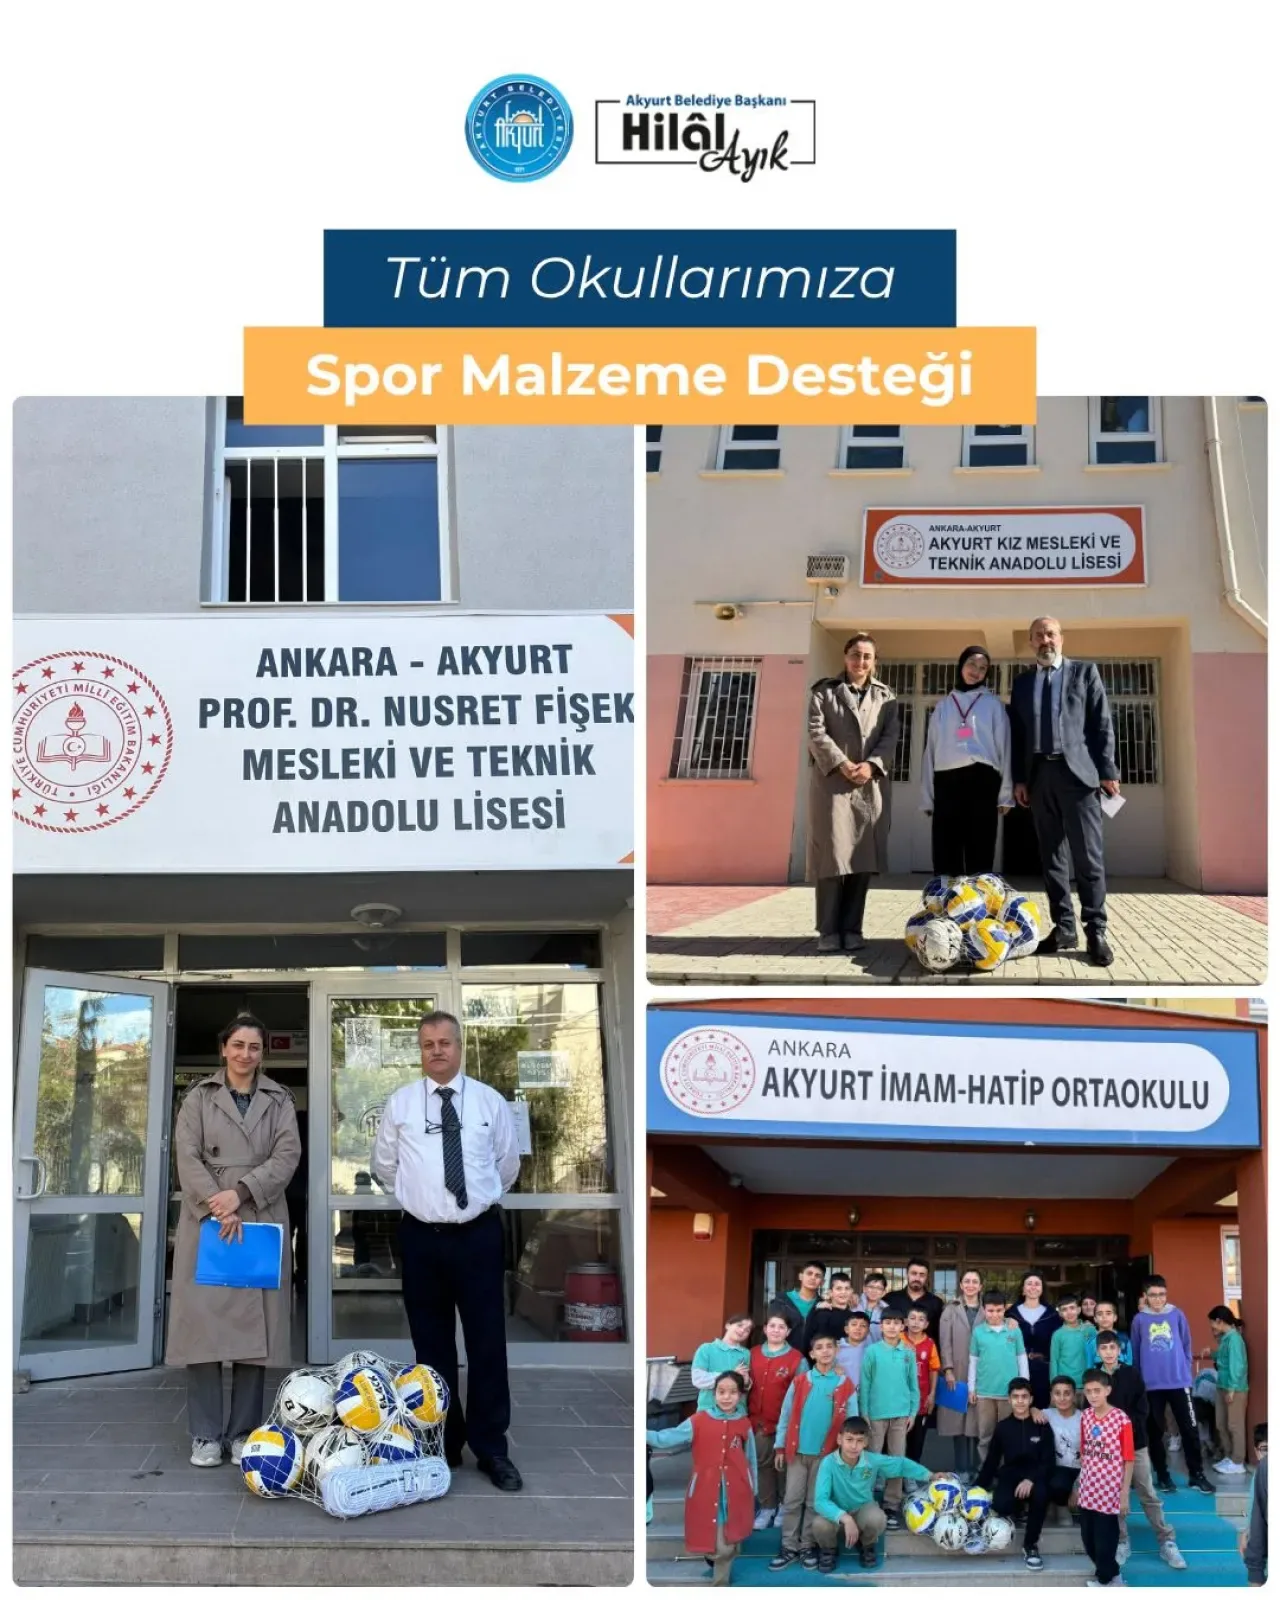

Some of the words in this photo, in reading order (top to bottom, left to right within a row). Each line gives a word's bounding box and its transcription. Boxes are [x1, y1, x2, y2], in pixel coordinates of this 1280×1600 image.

[928, 524, 1002, 533] ANKARA-AKYURT
[928, 536, 993, 551] AKYURT
[997, 536, 1022, 550] KIZ
[1026, 533, 1096, 550] MESLEKİ
[1099, 535, 1121, 549] VE
[928, 552, 986, 571] TEKNİK
[989, 556, 1067, 571] ANADOLU
[1071, 552, 1122, 570] LİSESİ
[255, 646, 398, 678] ANKARA
[436, 643, 573, 676] AKYURT
[73, 683, 110, 699] MİLLİ
[198, 697, 297, 729] PROF.
[311, 696, 370, 728] DR.
[384, 694, 522, 727] NUSRET
[535, 685, 635, 733] FİŞEK
[12, 683, 69, 754] CUMHURİYETİ
[109, 697, 138, 736] EĞİTİM
[15, 756, 59, 797] TÜRKİYE
[86, 739, 138, 796] BAKANLIĞI
[243, 739, 396, 781] MESLEKİ
[408, 746, 455, 778] VE
[466, 737, 597, 777] TEKNİK
[272, 798, 439, 834] ANADOLU
[453, 789, 566, 831] LİSESİ
[767, 1039, 852, 1059] ANKARA
[761, 1066, 874, 1101] AKYURT
[880, 1063, 1045, 1109] İMAM-HATİP
[1051, 1075, 1210, 1110] ORTAOKULU
